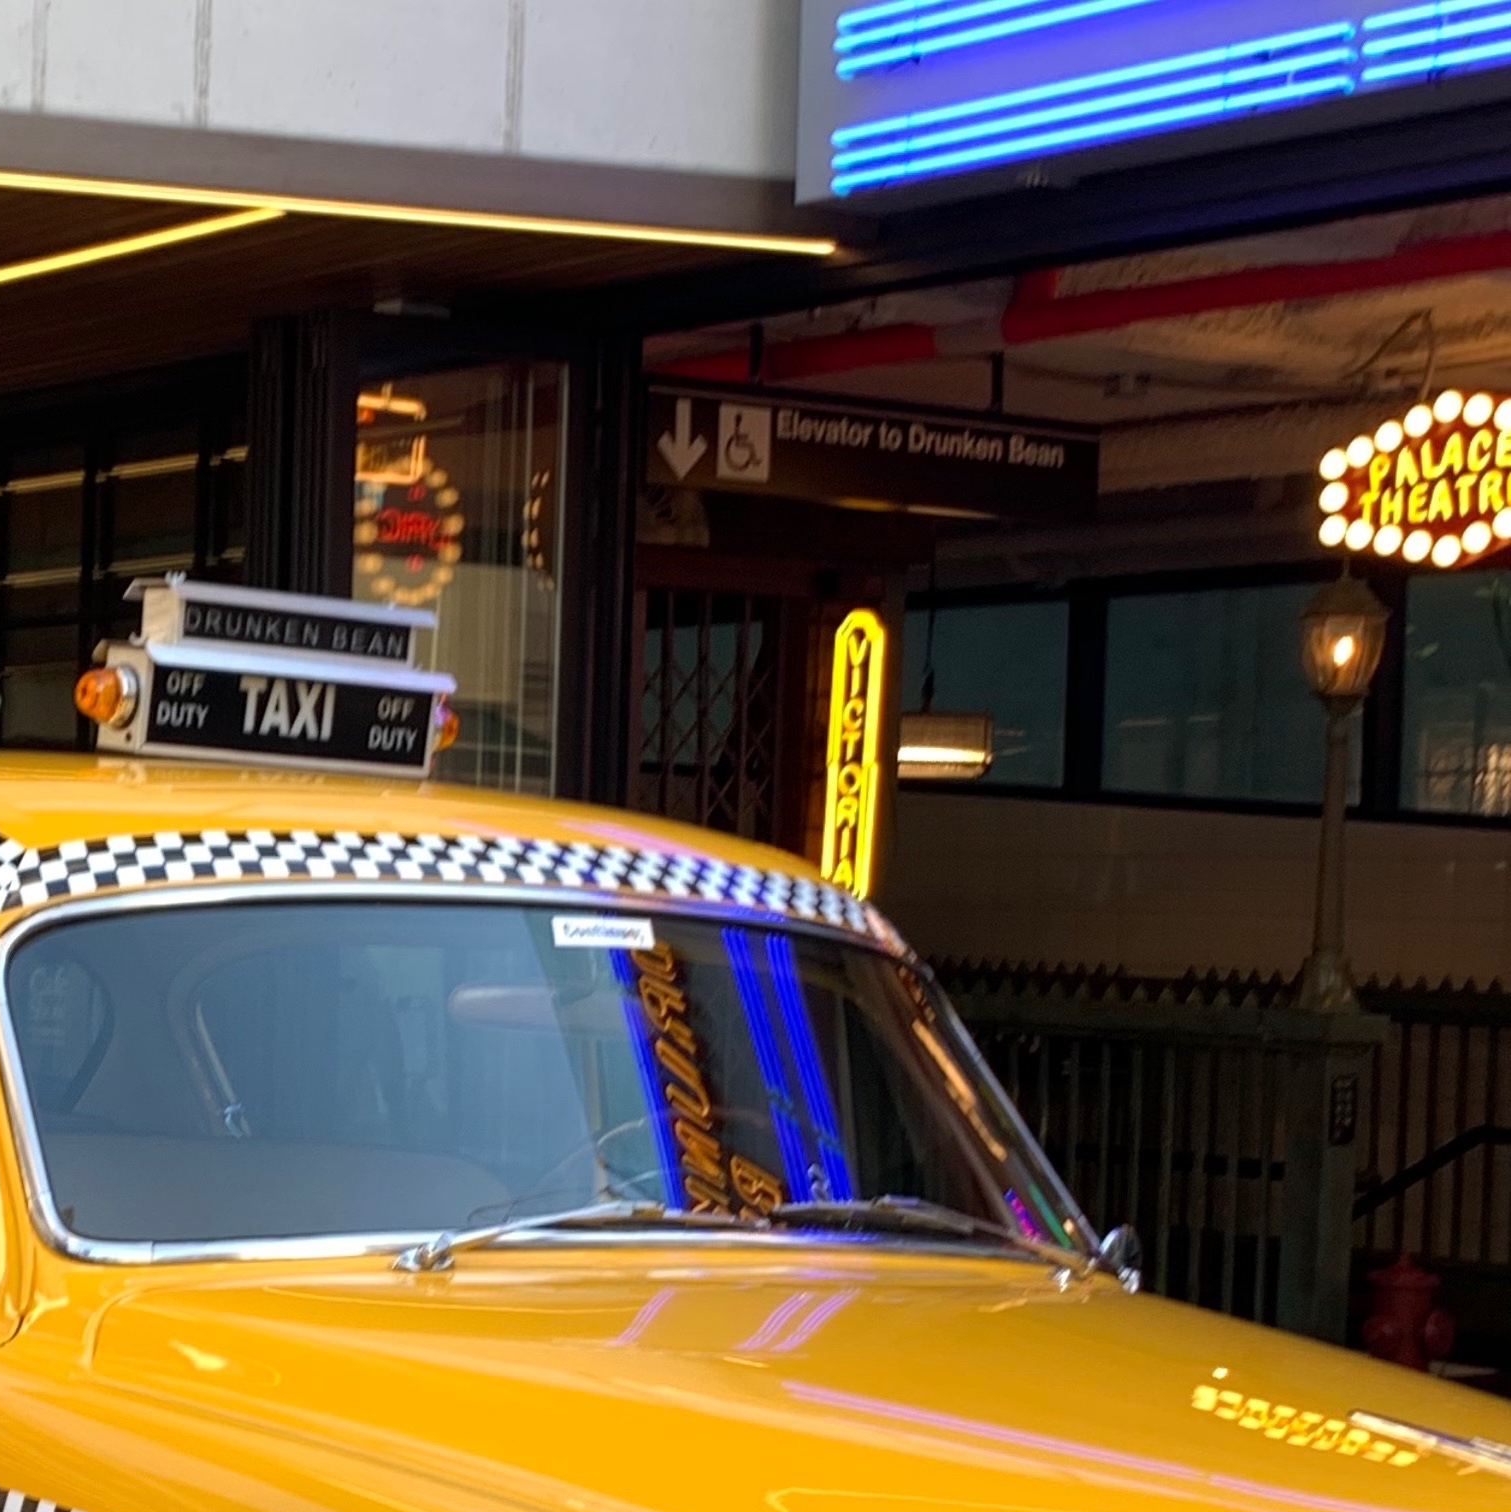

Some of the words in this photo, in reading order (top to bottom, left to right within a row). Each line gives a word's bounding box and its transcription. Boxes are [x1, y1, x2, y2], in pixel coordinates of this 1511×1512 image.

[776, 409, 871, 448] Elevator
[879, 420, 902, 452] to
[909, 423, 1003, 462] Drunken
[1008, 434, 1065, 469] Bean
[1368, 428, 1511, 494] PALACE
[1359, 469, 1511, 527] THEATR
[187, 607, 319, 648] DRUNKEN
[331, 626, 405, 658] BEAN
[166, 669, 206, 697] OFF
[239, 675, 335, 742] TAXI
[156, 701, 209, 729] DUTY
[377, 696, 414, 722] OFF
[367, 725, 418, 753] DUTY
